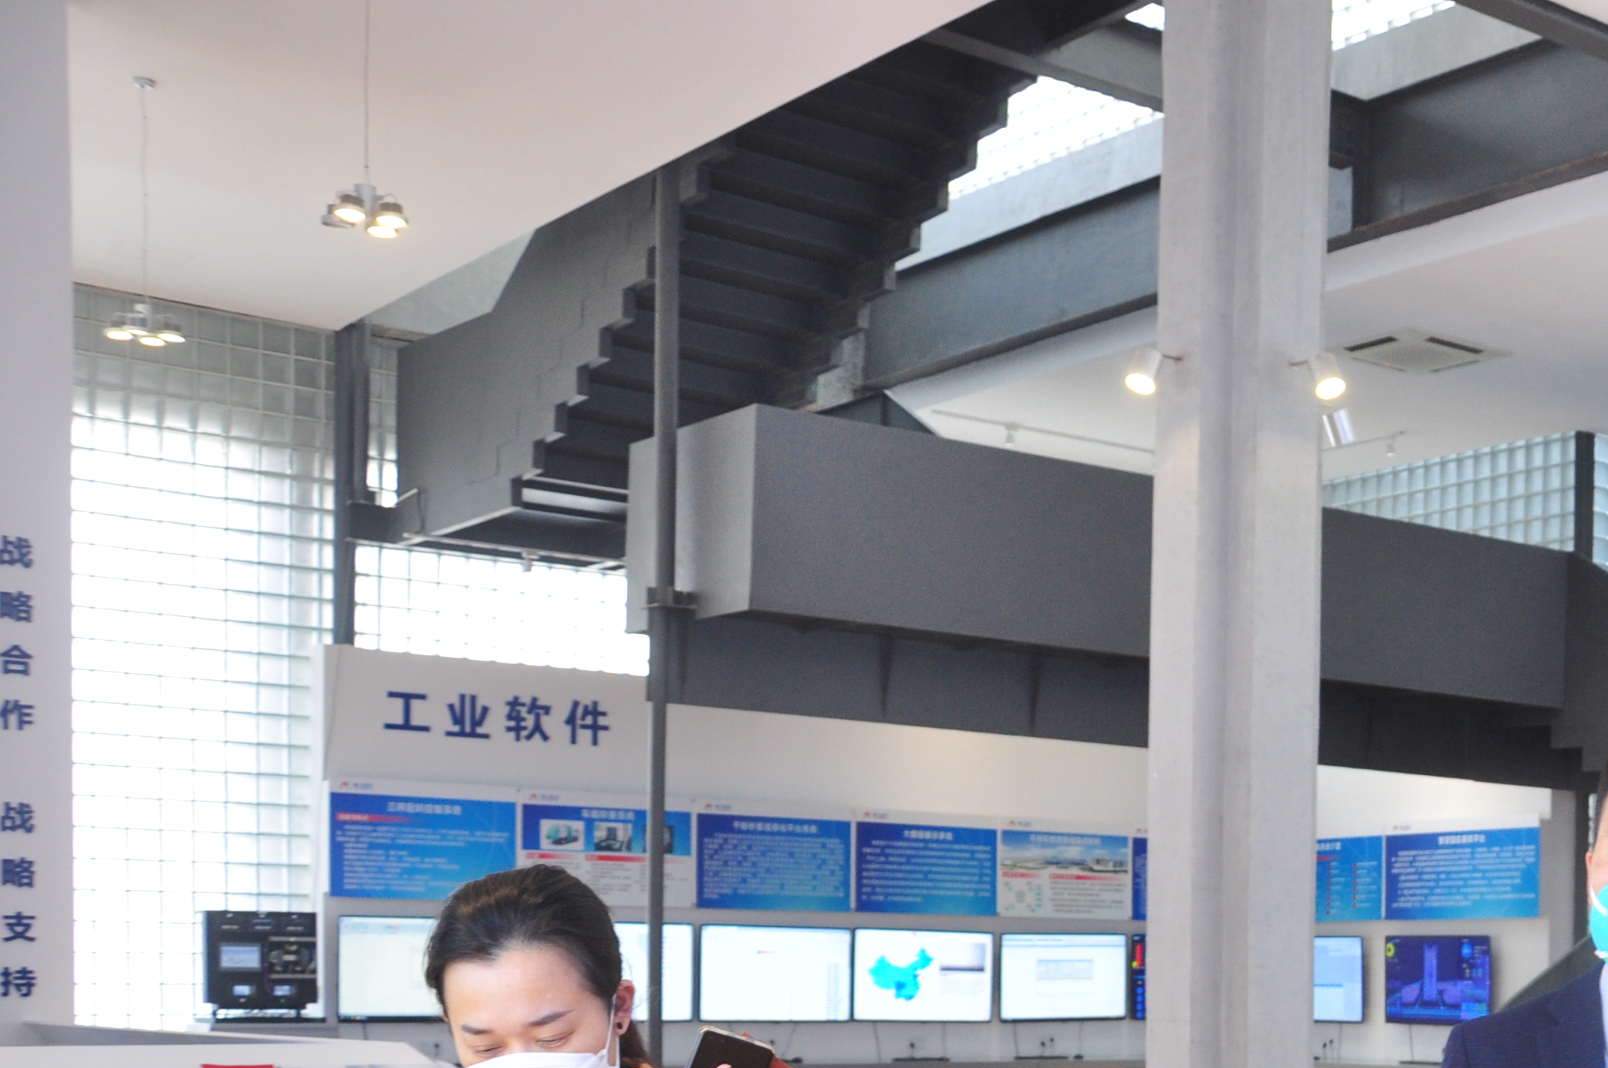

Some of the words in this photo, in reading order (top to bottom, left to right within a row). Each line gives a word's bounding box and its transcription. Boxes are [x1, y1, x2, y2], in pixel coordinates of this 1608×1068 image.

[0, 534, 35, 732] 战略合作
[383, 690, 610, 746] 工业软件
[0, 801, 37, 998] 战略支持
